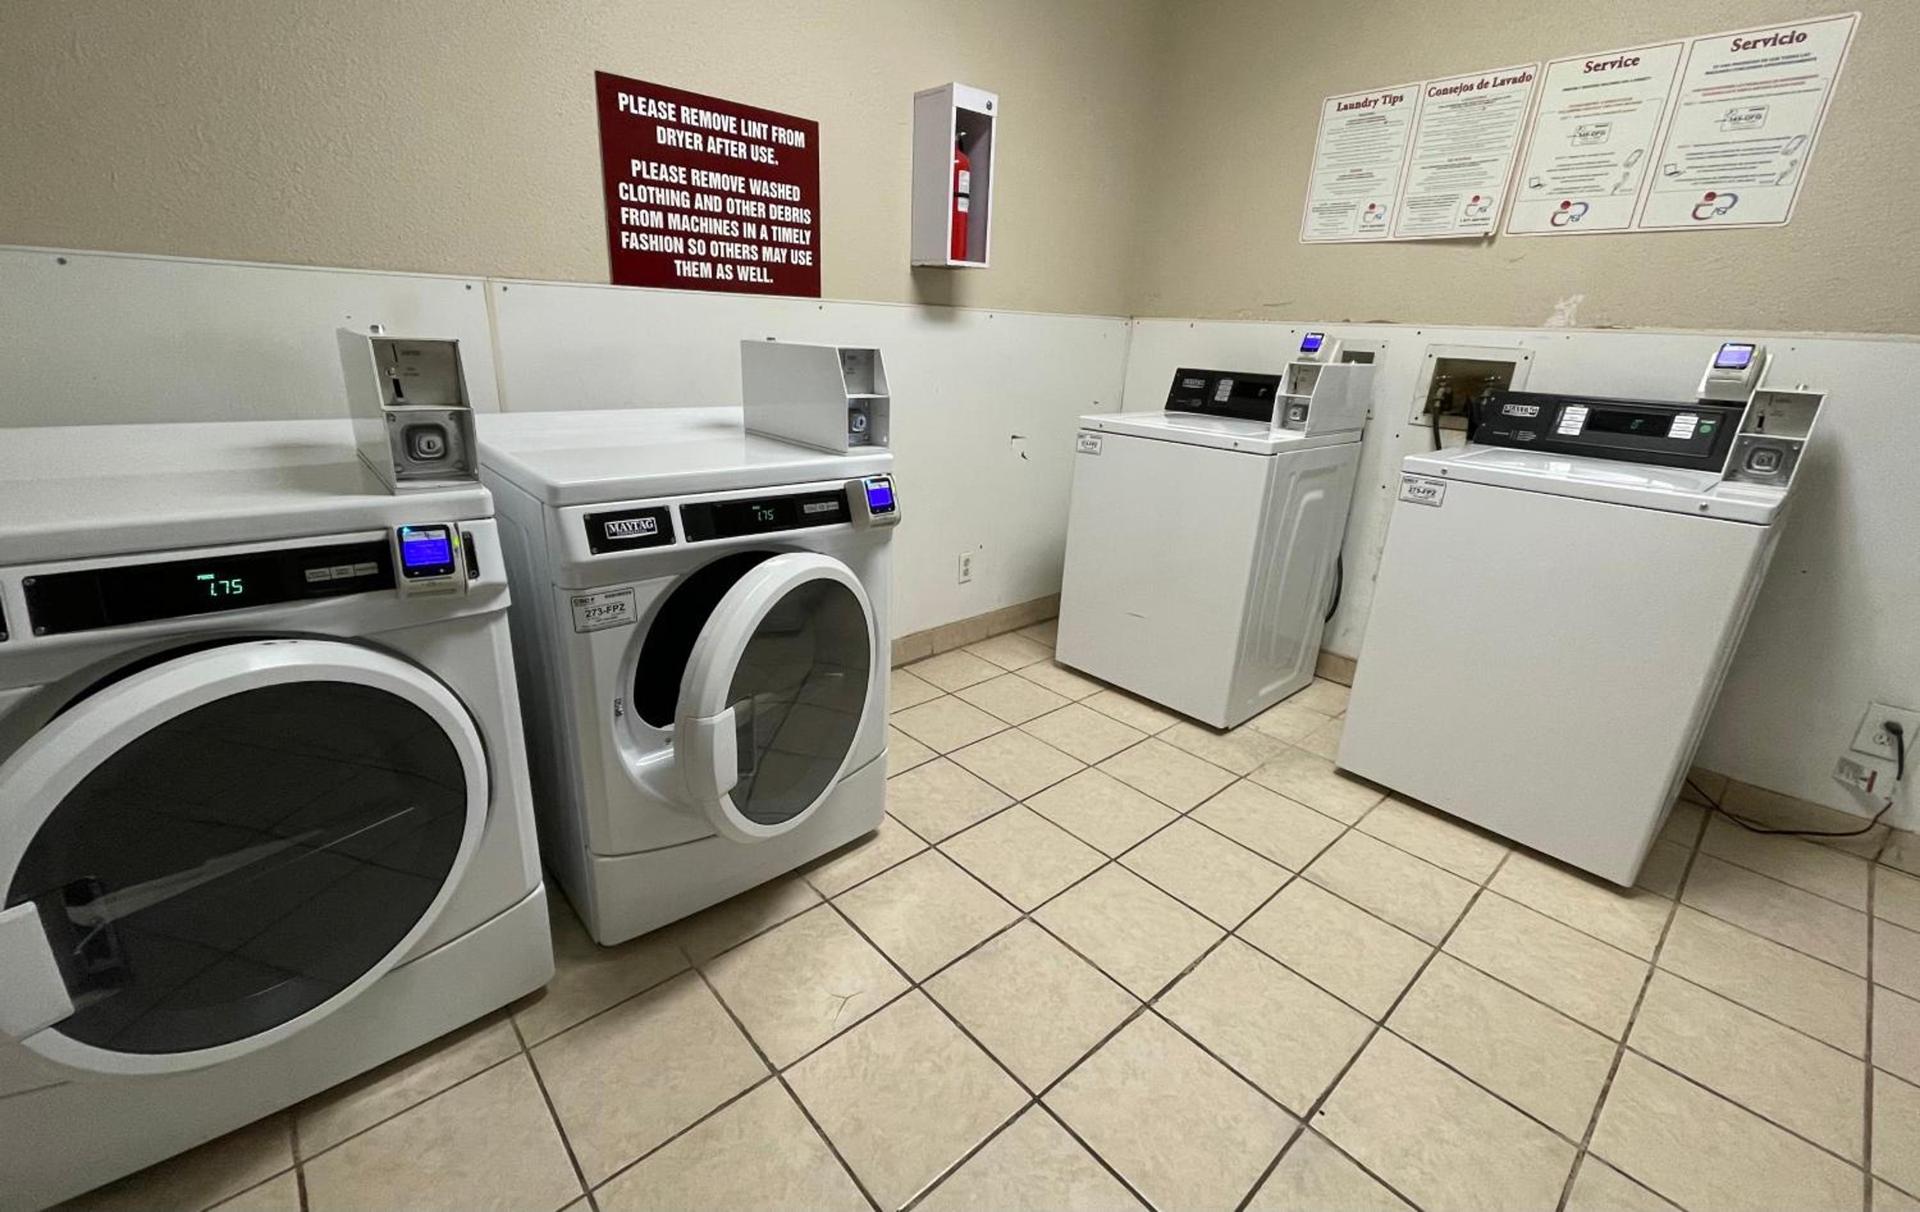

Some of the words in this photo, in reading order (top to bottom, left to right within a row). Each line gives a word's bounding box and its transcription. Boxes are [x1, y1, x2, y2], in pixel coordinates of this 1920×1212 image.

[1730, 31, 1807, 52] Servicio
[1583, 56, 1640, 74] Service
[1428, 82, 1474, 97] Consejos
[1476, 79, 1490, 90] de
[1492, 72, 1533, 88] Lavado
[1336, 97, 1379, 112] Laundry
[1381, 94, 1404, 106] Tips
[618, 92, 677, 122] PLEASE
[680, 106, 737, 134] REMOVE
[740, 119, 768, 140] LINT
[771, 125, 805, 148] FROM
[656, 125, 703, 151] DRYER
[707, 136, 747, 159] AFTER
[750, 144, 778, 165] USE.
[631, 159, 687, 185] PLEASE
[691, 169, 746, 194] REMOVE
[749, 178, 800, 201] WASHED
[618, 182, 691, 208] CLOTHING
[694, 193, 722, 213] AND
[726, 197, 766, 219] OTHER
[769, 203, 811, 224] DEBRIS
[621, 207, 664, 229] FROM
[667, 212, 739, 237] MACHINES
[743, 222, 756, 239] IN
[759, 224, 768, 241] A
[771, 226, 811, 245] TIMELY
[621, 231, 684, 254] FASHION
[687, 238, 706, 256] SO
[710, 240, 758, 261] OTHERS
[762, 246, 787, 263] MAY
[790, 249, 812, 266] USE
[674, 260, 712, 279] THEM
[716, 263, 734, 280] AS
[737, 265, 774, 283] WELL.
[608, 519, 655, 534] MAYTAG
[584, 603, 626, 618] 273-FPZ
